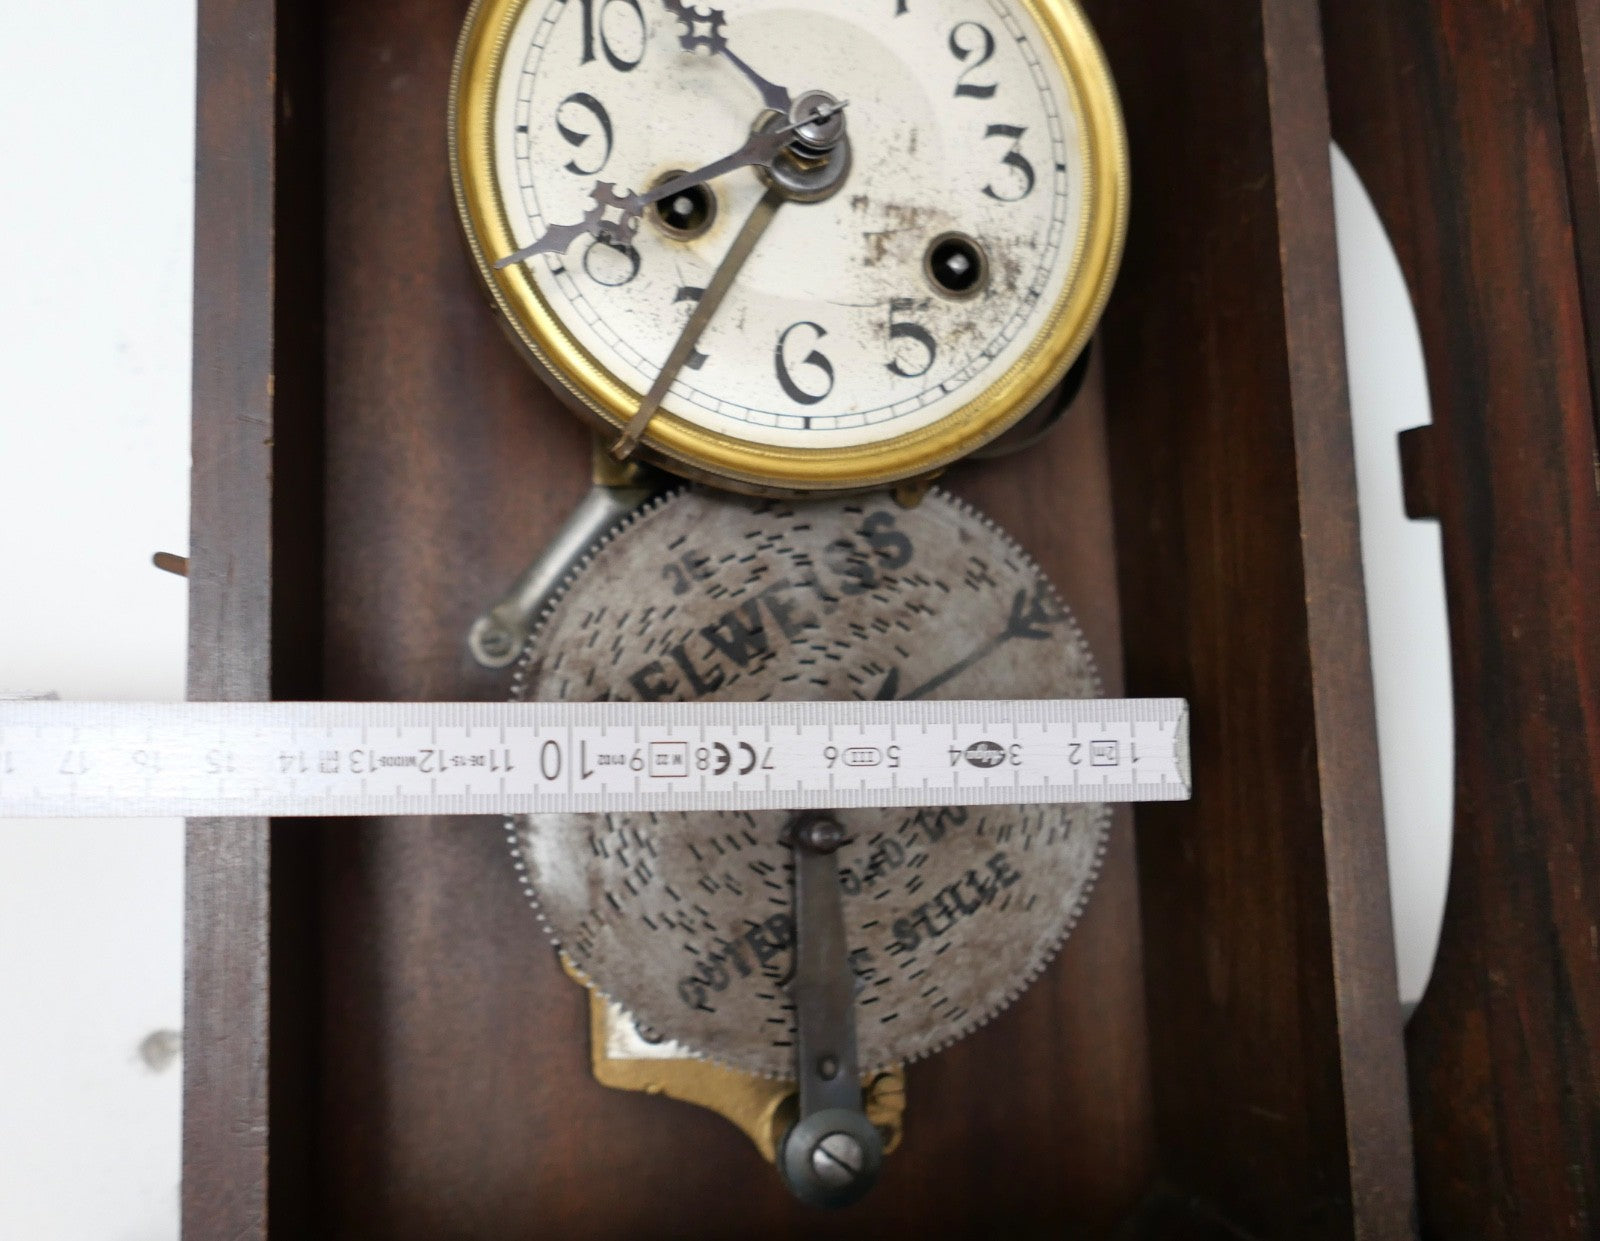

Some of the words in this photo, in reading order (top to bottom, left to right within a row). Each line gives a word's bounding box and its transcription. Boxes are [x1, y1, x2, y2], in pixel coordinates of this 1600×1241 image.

[578, 0, 646, 72] 10
[948, 21, 998, 99] 2
[556, 92, 613, 176] 9
[981, 124, 1036, 202] 3
[884, 297, 937, 378] 5
[774, 321, 834, 405] 6
[279, 750, 308, 774] 14
[350, 749, 377, 773] 13
[419, 749, 448, 773] 12
[490, 749, 514, 772] 11
[629, 748, 645, 771] 9
[695, 747, 709, 771] 8
[761, 747, 775, 769] 7
[823, 746, 838, 769] 6
[886, 745, 900, 768] 5
[948, 745, 963, 767] 4
[1009, 743, 1022, 766] 3
[1068, 743, 1082, 765] 2
[1131, 742, 1140, 763] 1
